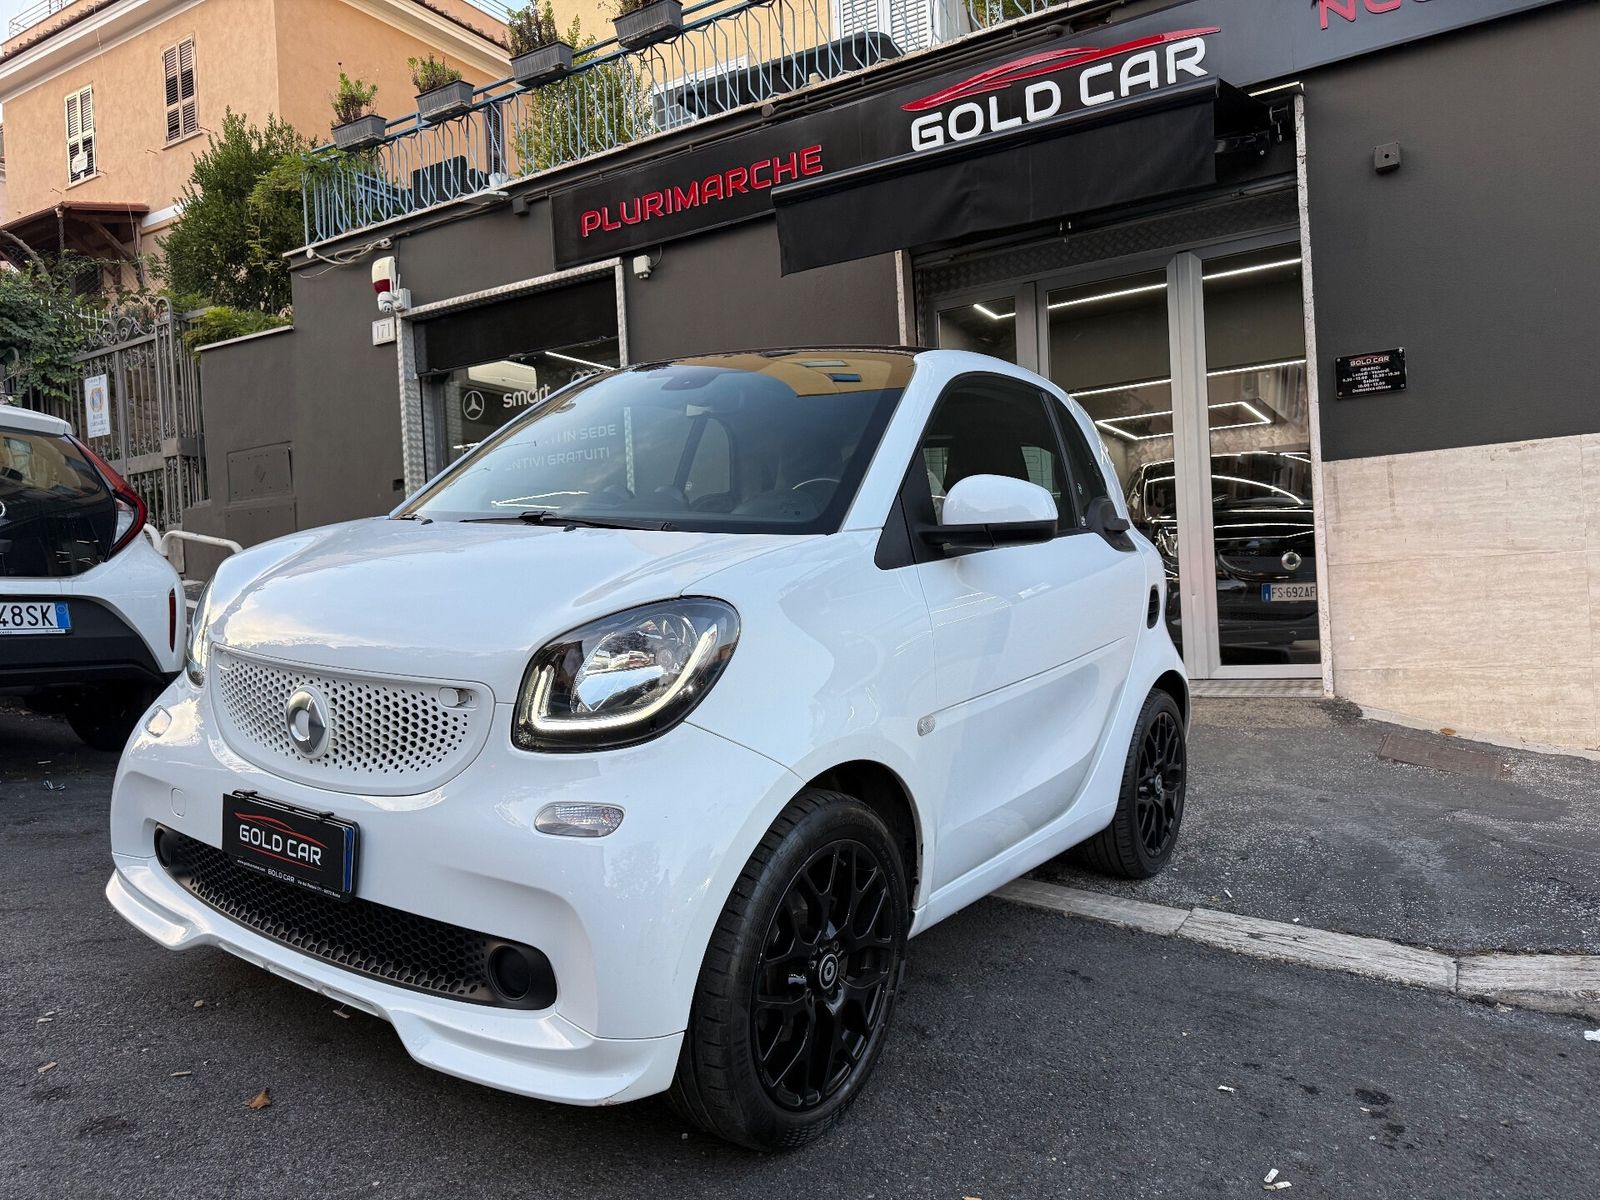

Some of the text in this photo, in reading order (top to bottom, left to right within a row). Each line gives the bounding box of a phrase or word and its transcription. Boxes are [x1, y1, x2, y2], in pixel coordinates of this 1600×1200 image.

[911, 37, 1208, 151] GOLD CAR
[581, 144, 823, 237] PLURIMARCHE
[1350, 359, 1372, 367] GOLD
[503, 384, 550, 408] smart
[580, 424, 617, 440] SEDE
[547, 446, 610, 465] GRATUITI
[240, 824, 322, 865] GOLD CAR
[267, 868, 295, 883] GOLD CAR
